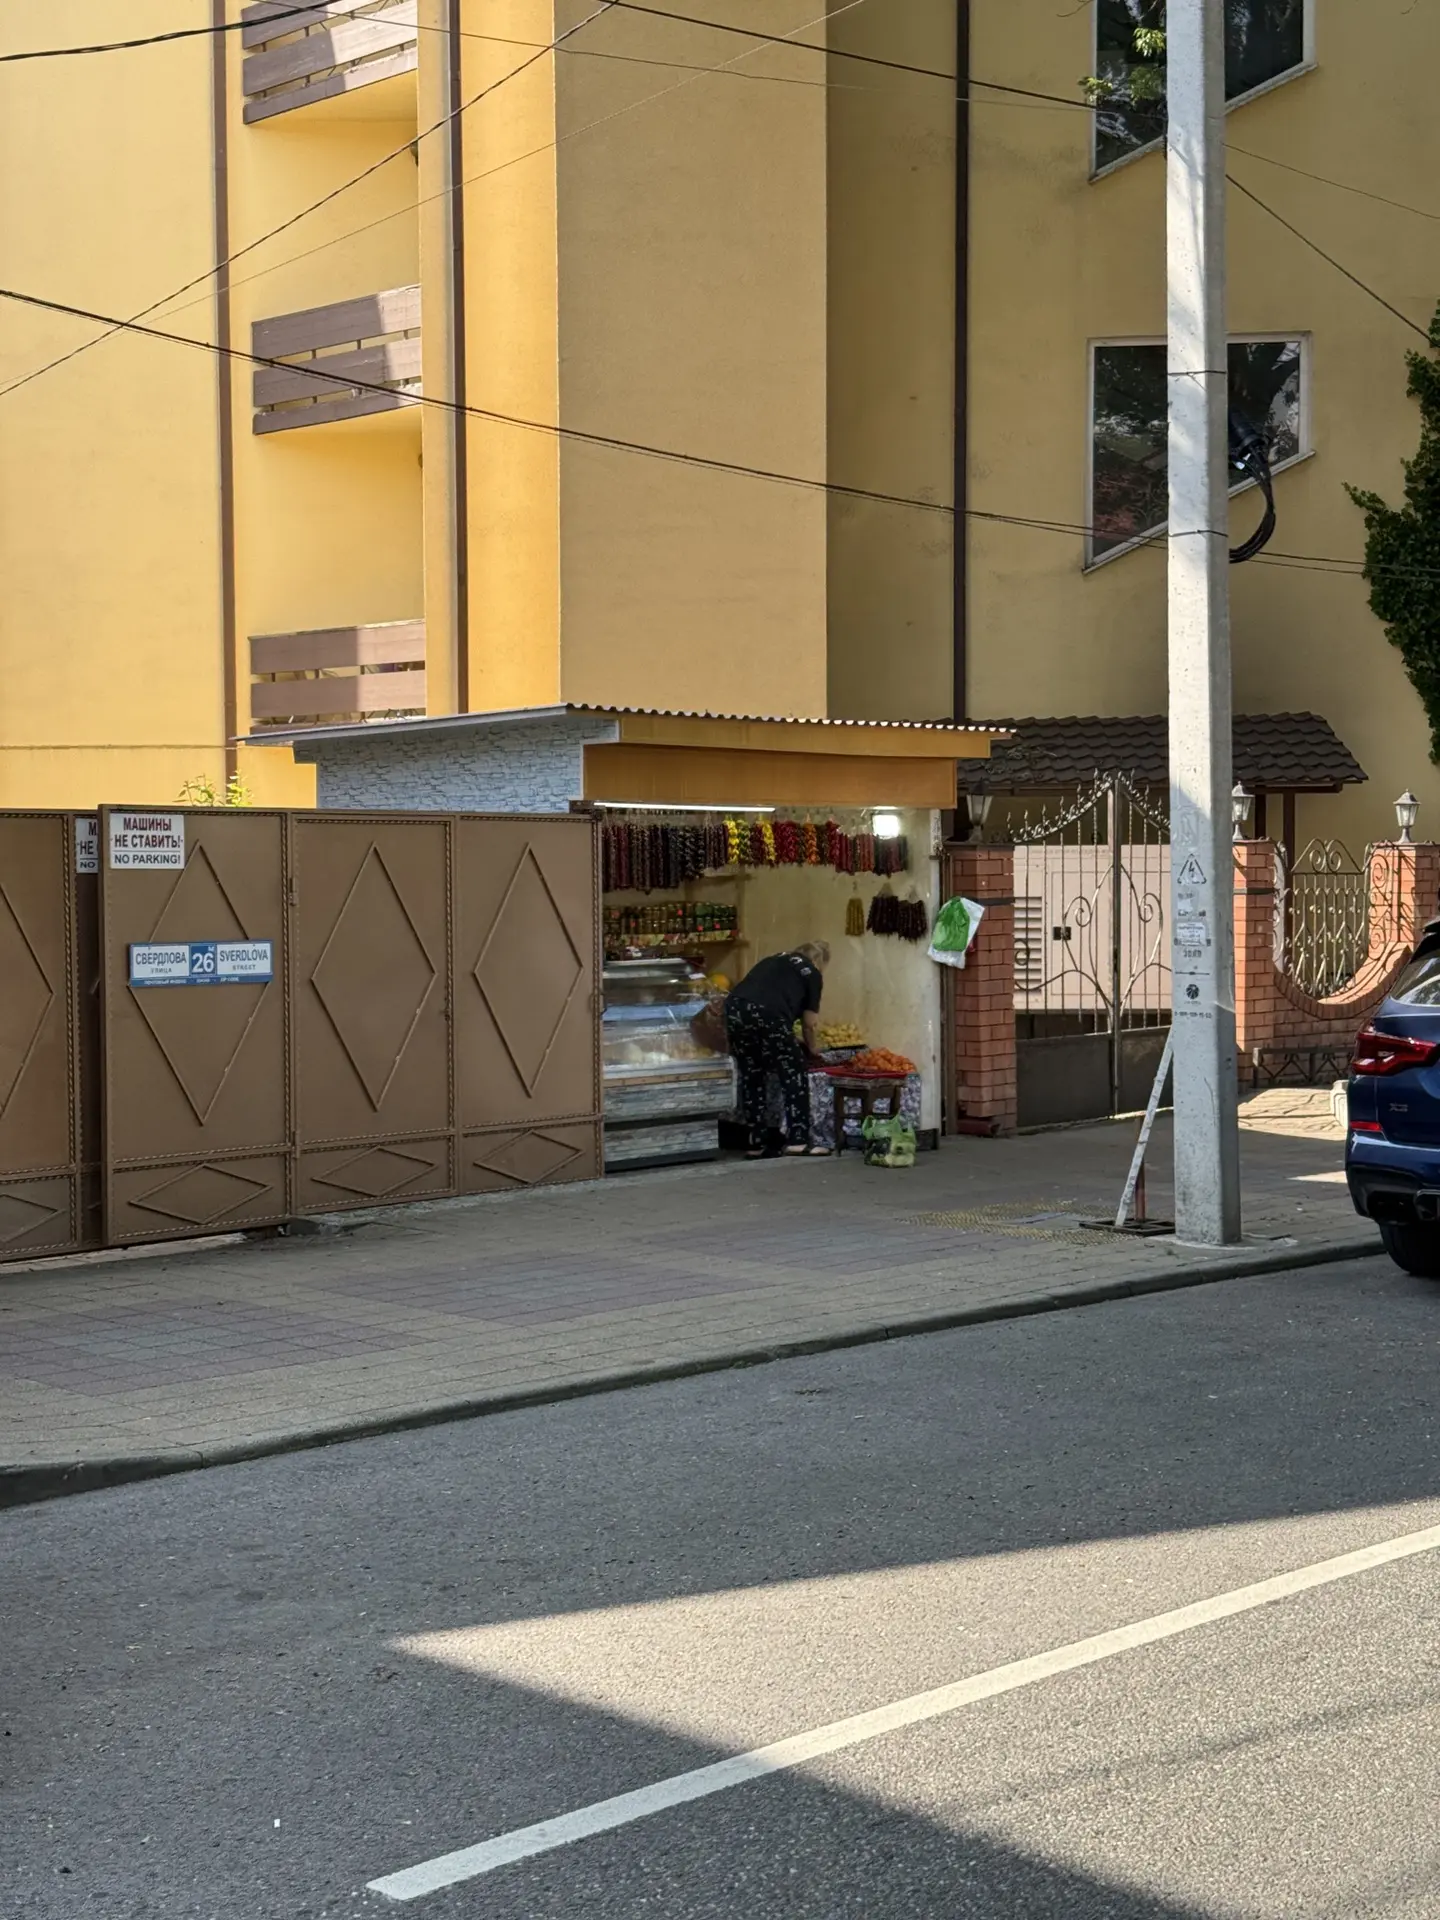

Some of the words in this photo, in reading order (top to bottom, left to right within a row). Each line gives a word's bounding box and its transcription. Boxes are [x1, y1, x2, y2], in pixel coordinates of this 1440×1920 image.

[123, 817, 172, 831] МАШИНЫ
[80, 840, 94, 855] НЕ
[114, 834, 128, 848] НЕ
[131, 834, 181, 849] СТАВИТЬ!
[80, 861, 96, 869] NO
[114, 854, 130, 864] NO
[132, 854, 181, 865] PARKING!
[135, 951, 187, 966] СВЕРДЛОВА
[219, 948, 269, 962] SVERDLOVA
[191, 952, 215, 973] 26
